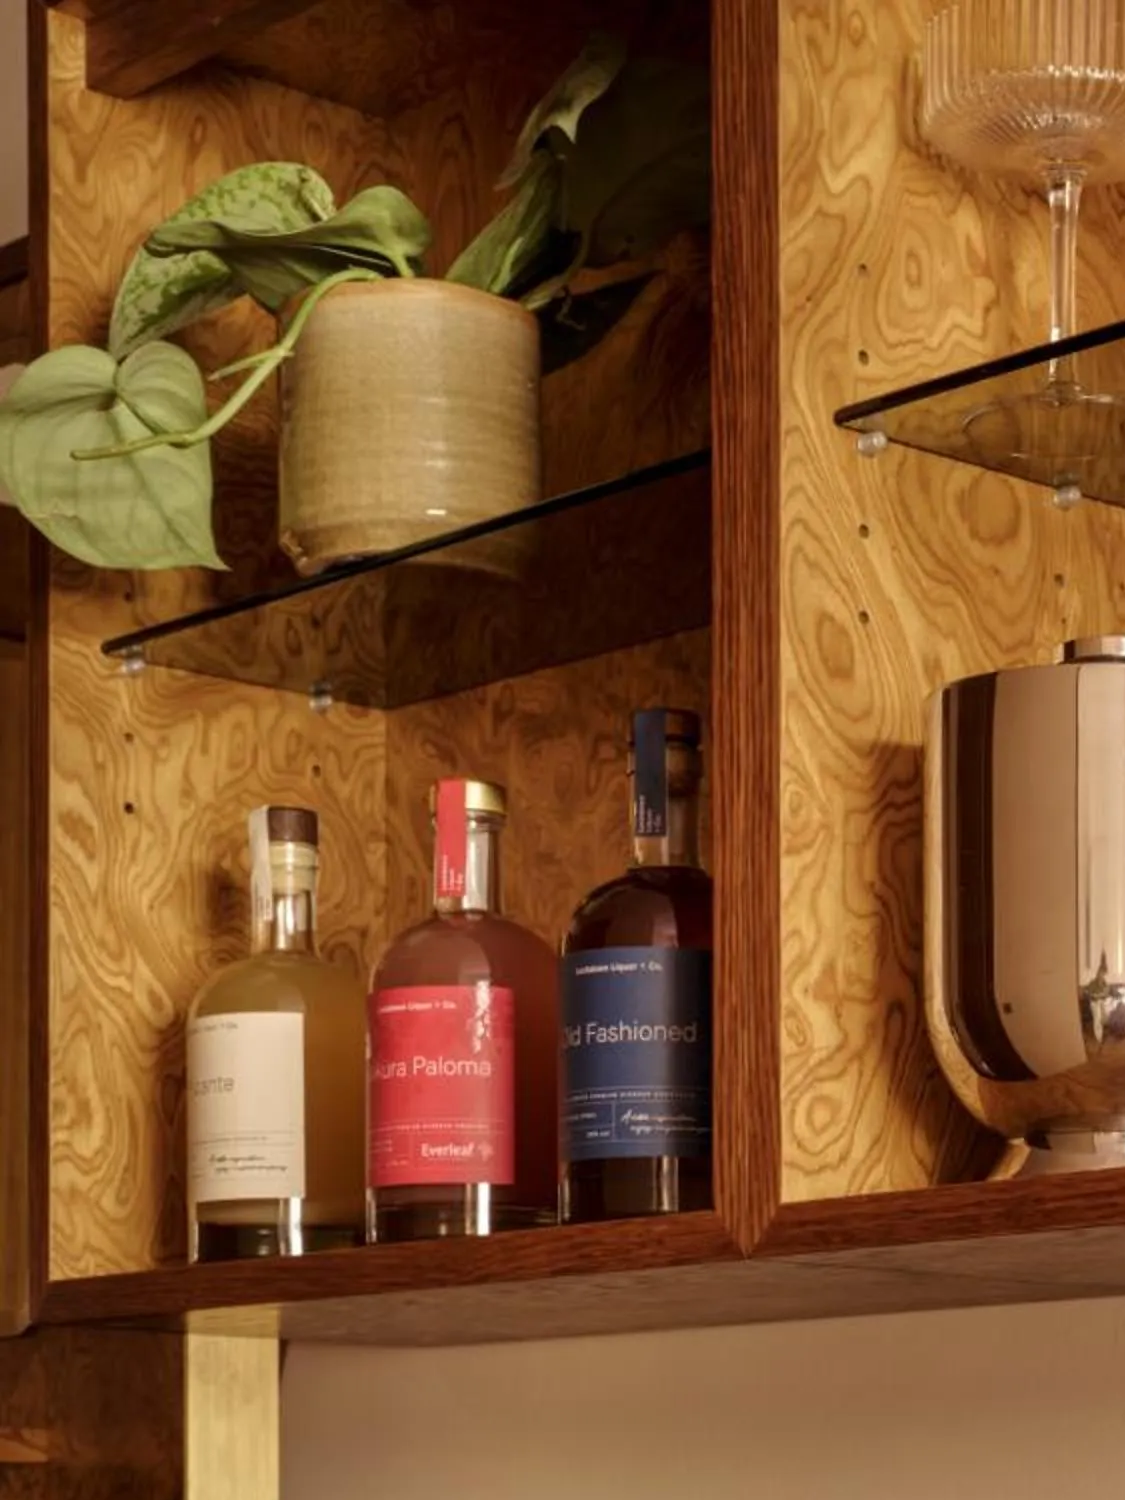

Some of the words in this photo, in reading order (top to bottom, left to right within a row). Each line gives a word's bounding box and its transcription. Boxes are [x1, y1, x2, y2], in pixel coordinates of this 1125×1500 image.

[586, 1019, 698, 1045] Fashioned
[412, 1055, 492, 1077] Paloma
[420, 1142, 476, 1158] Everleaf
